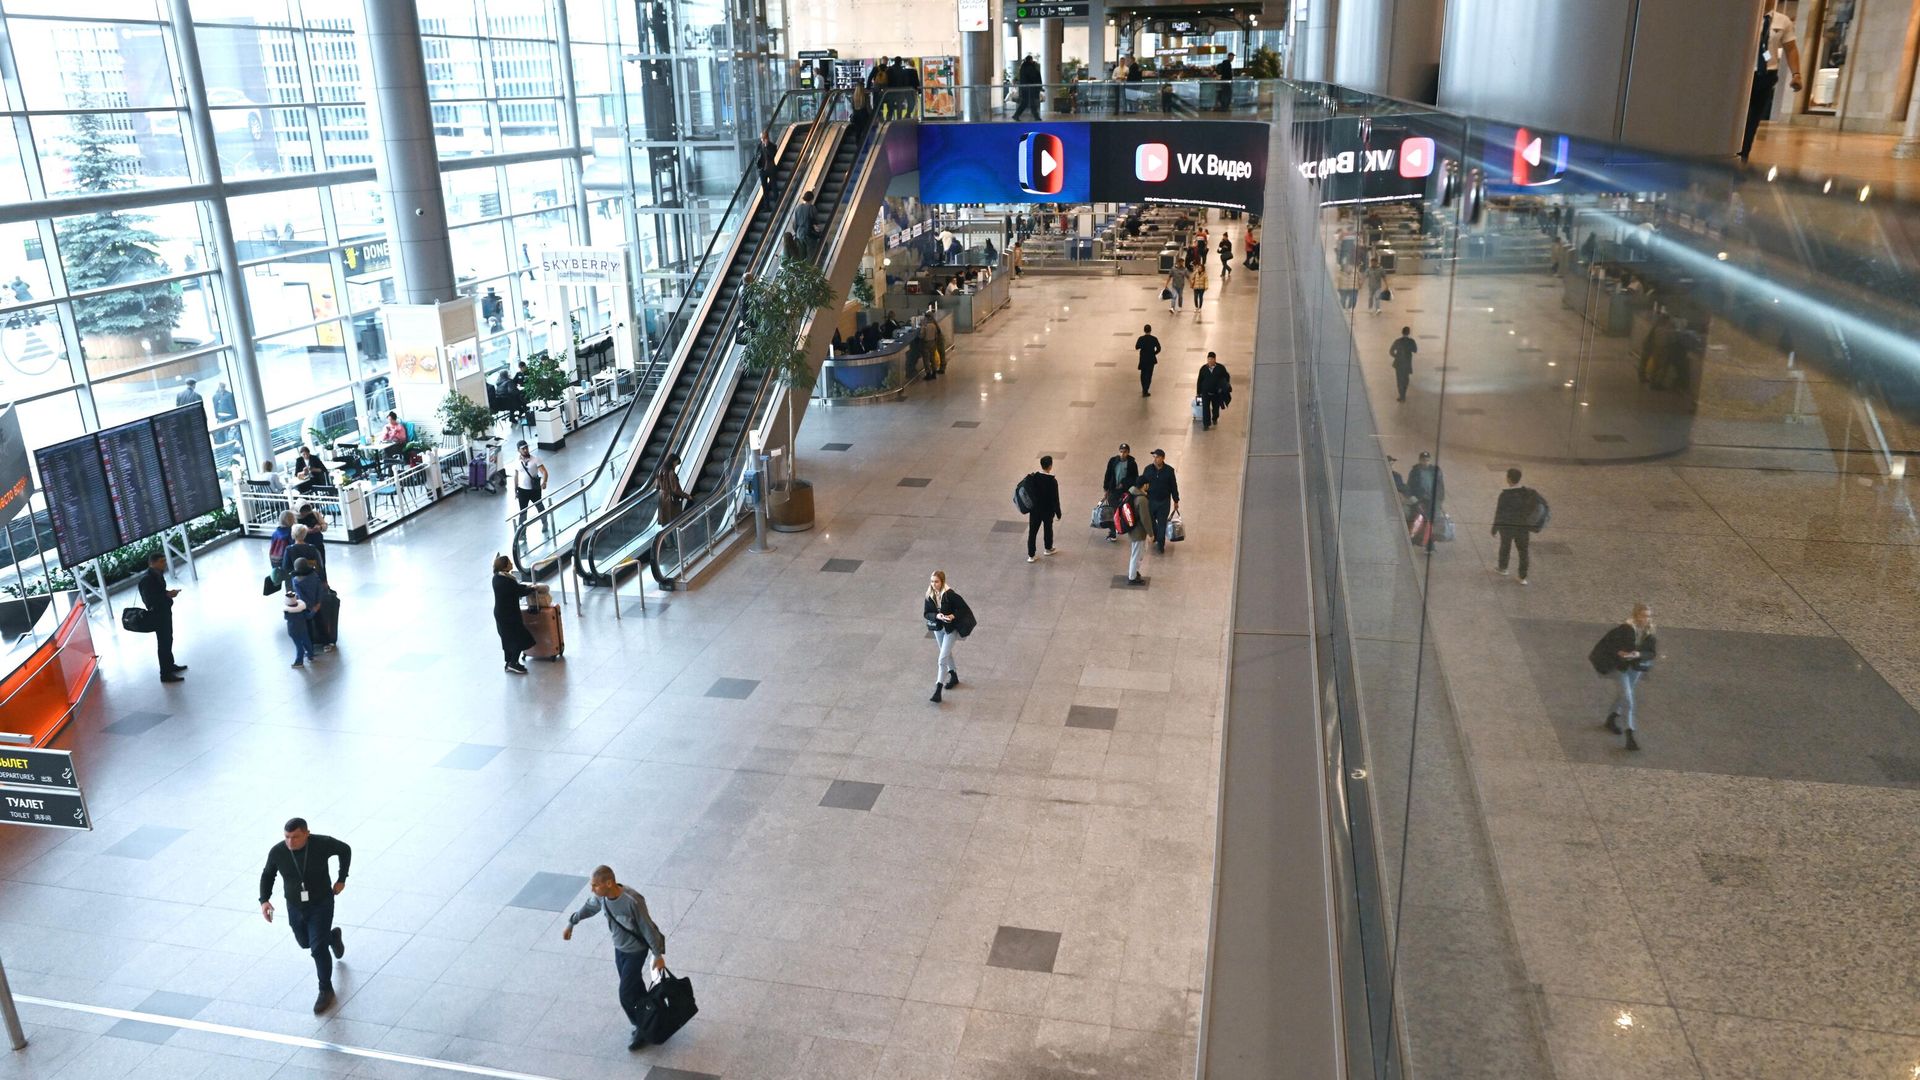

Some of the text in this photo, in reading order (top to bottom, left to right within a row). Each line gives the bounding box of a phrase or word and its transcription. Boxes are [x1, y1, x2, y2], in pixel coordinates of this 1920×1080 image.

[1176, 153, 1252, 181] VK Видео
[543, 258, 618, 272] SKYBERRY
[5, 796, 44, 810] ТУАЛЕТ
[9, 811, 30, 819] TOILET
